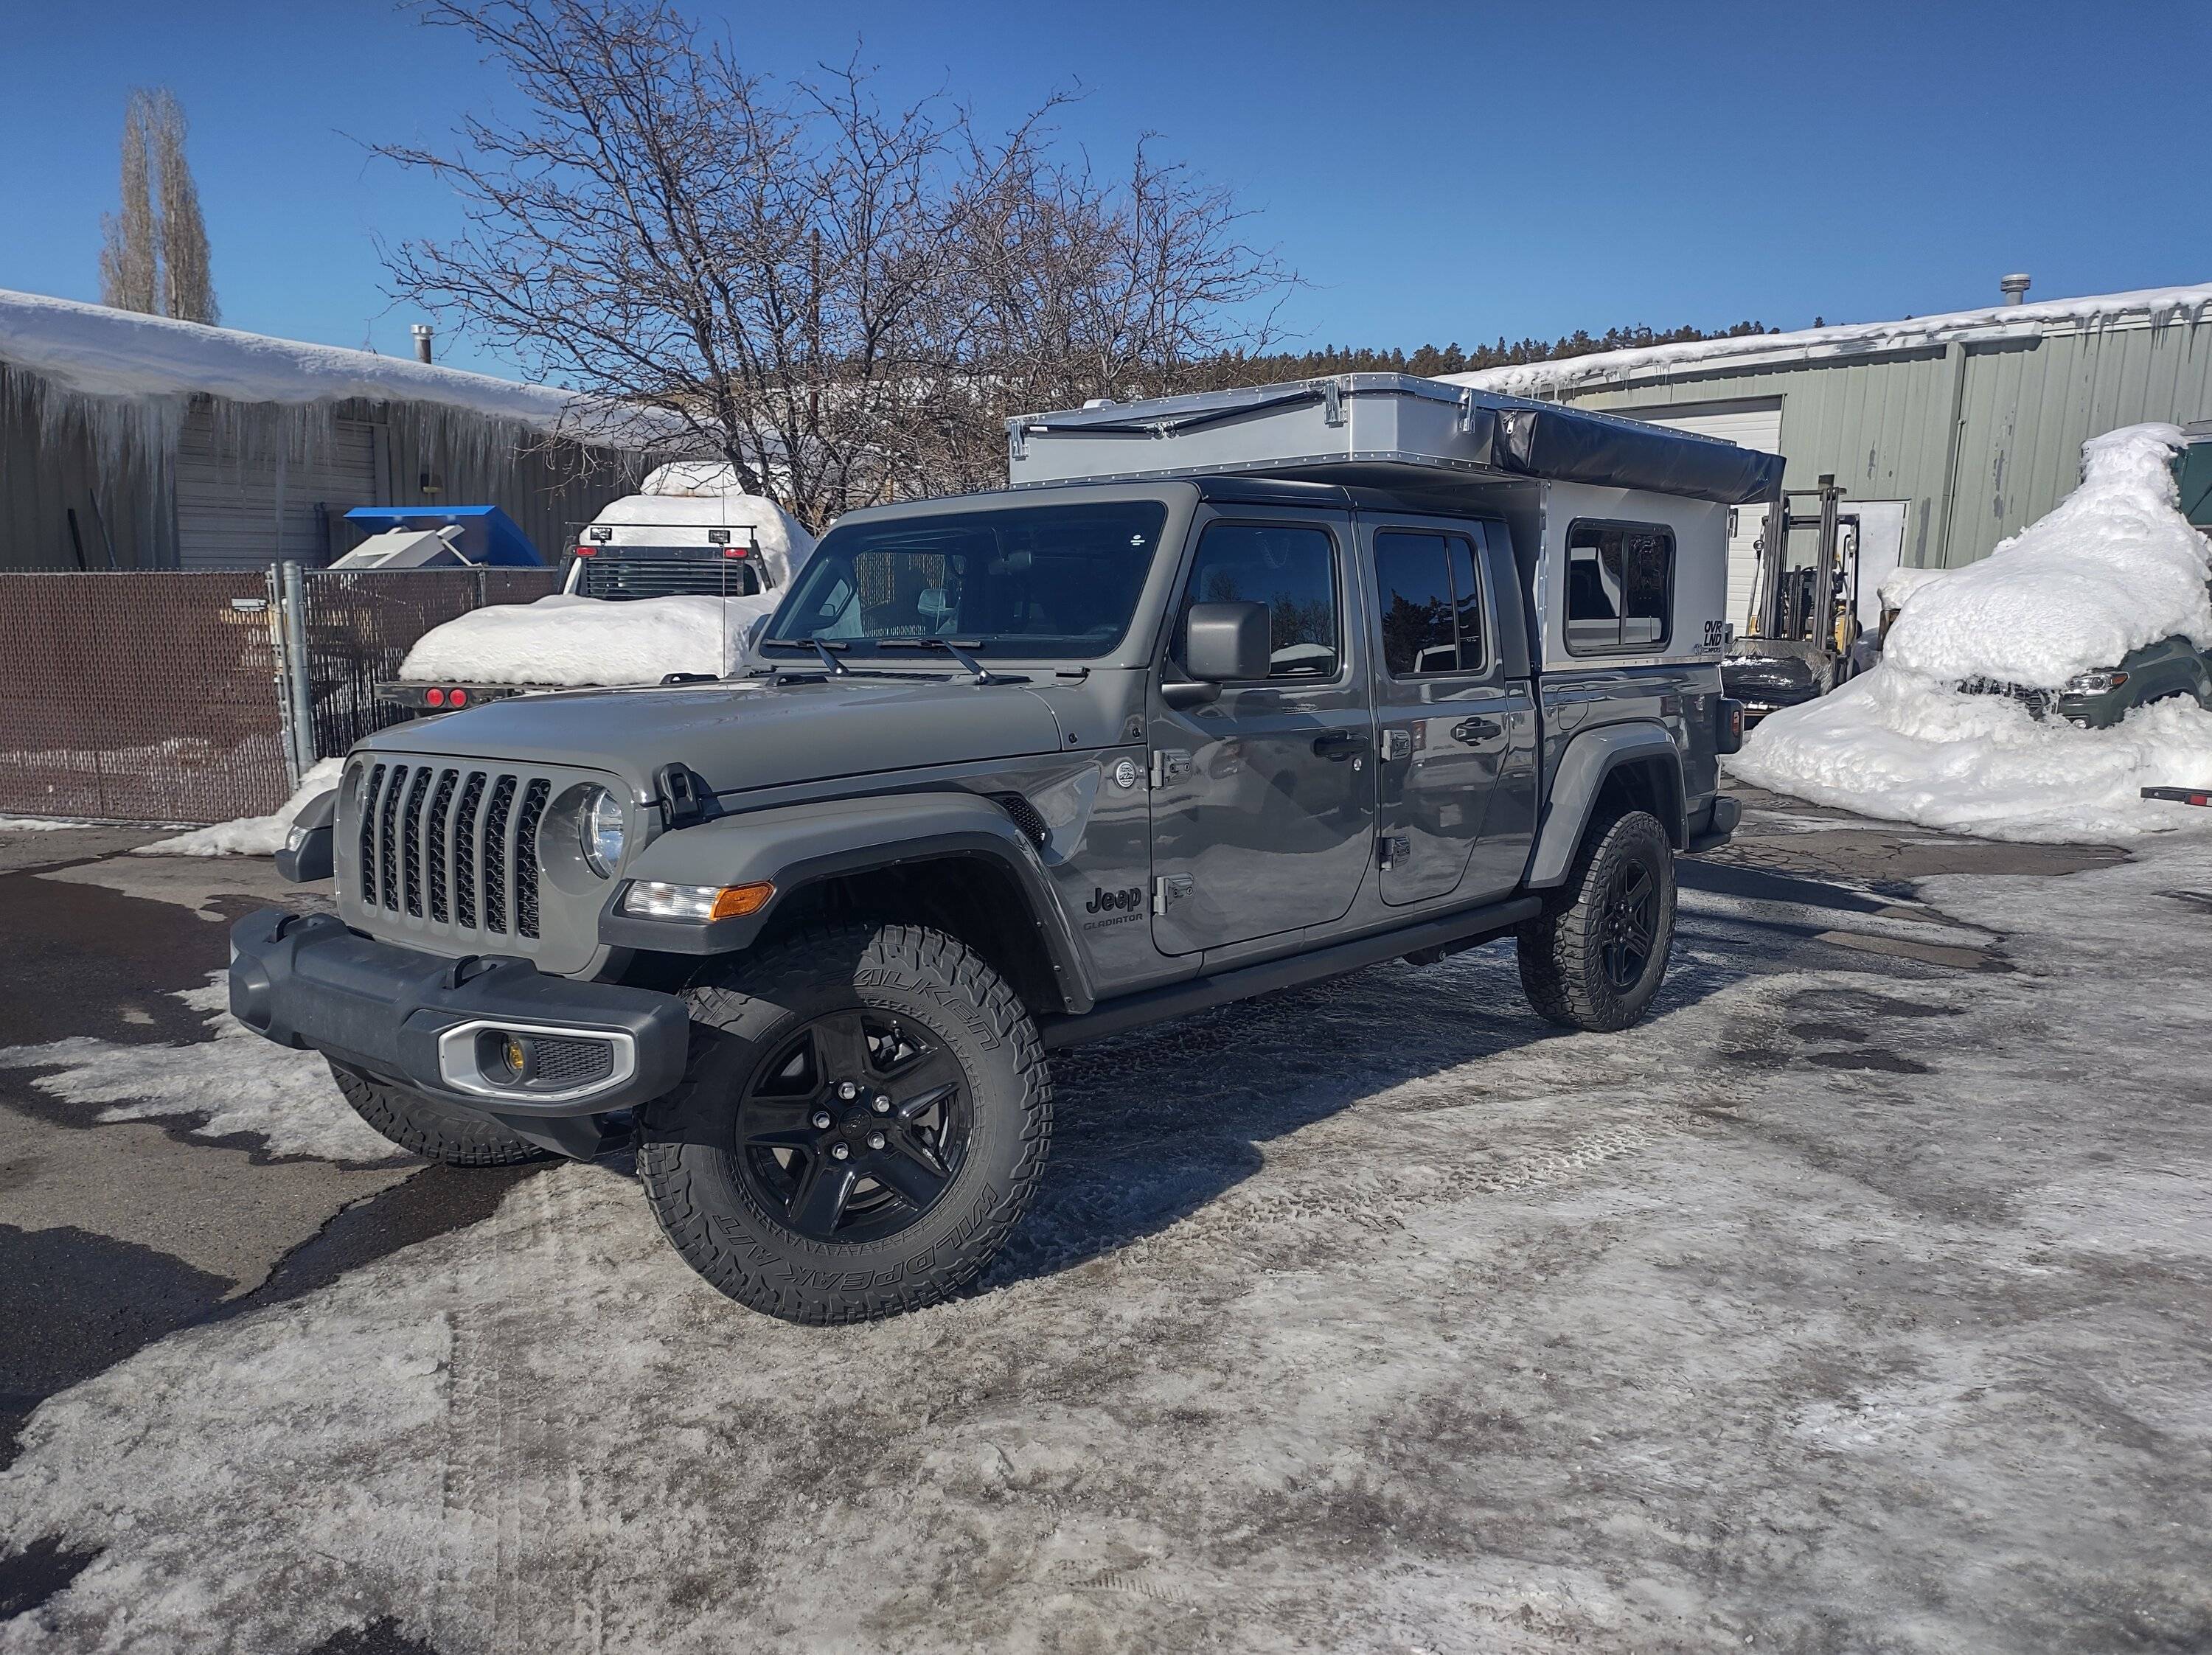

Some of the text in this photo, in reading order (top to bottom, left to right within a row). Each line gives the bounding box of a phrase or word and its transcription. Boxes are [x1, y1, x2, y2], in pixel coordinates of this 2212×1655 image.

[1704, 620, 1722, 633] OVR
[1703, 633, 1722, 647] LND
[1086, 887, 1141, 914] Jeep
[1083, 913, 1143, 930] GLADIATOR
[807, 967, 1001, 1052] ALKEN
[774, 1182, 998, 1291] WILDPEAK
